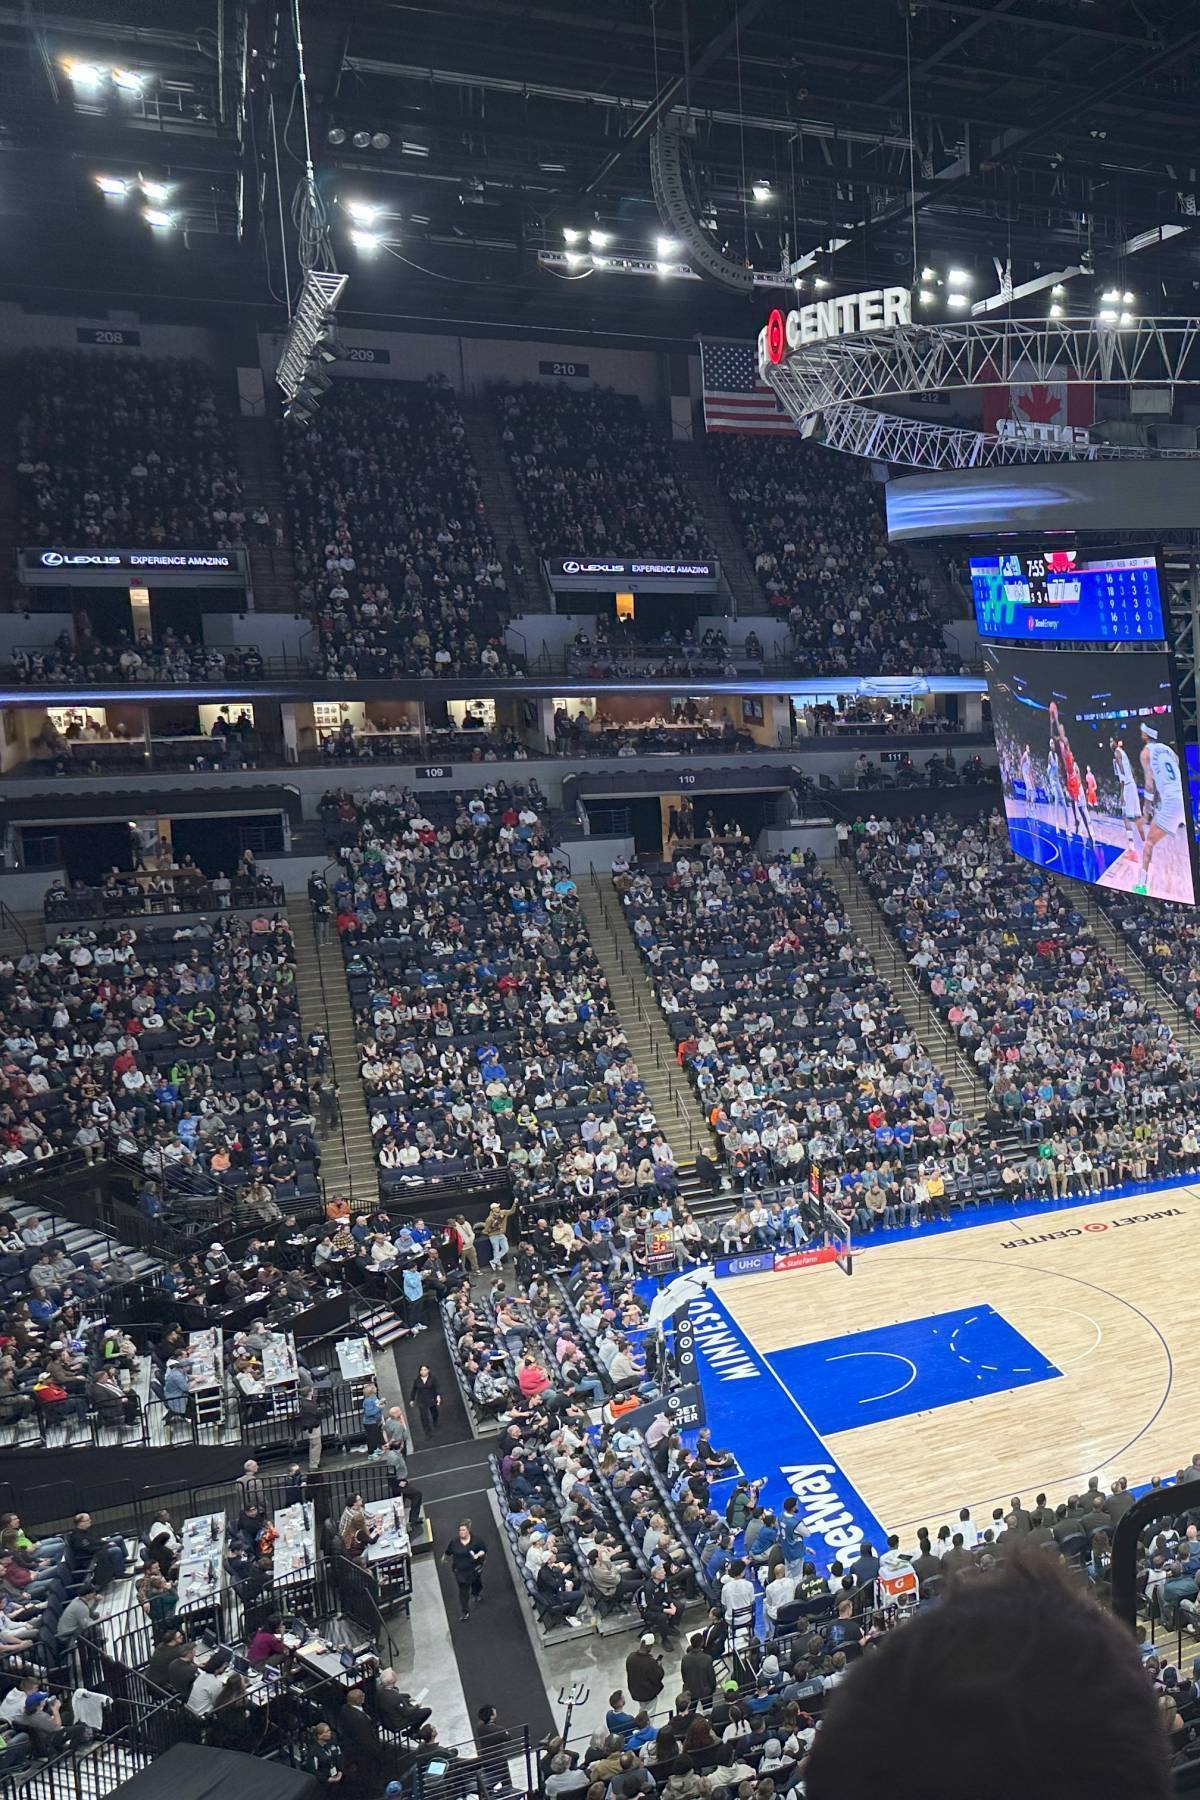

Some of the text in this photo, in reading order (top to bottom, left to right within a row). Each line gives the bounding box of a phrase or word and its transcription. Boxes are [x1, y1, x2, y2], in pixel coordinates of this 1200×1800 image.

[786, 286, 912, 348] CENTER
[95, 331, 123, 344] 208
[350, 349, 375, 361] 209
[553, 364, 575, 376] 210
[64, 556, 229, 566] LEXUS EXPERIENCE AMAZING
[632, 565, 675, 573] EXPERIENCE
[677, 566, 709, 574] AMAZING
[1027, 560, 1044, 577] 7:55
[425, 768, 443, 777] 109
[1165, 762, 1176, 781] 9
[679, 775, 695, 783] 110
[1000, 1208, 1187, 1250] TARGET CENTER
[739, 1259, 761, 1269] UHC
[895, 1577, 905, 1588] G
